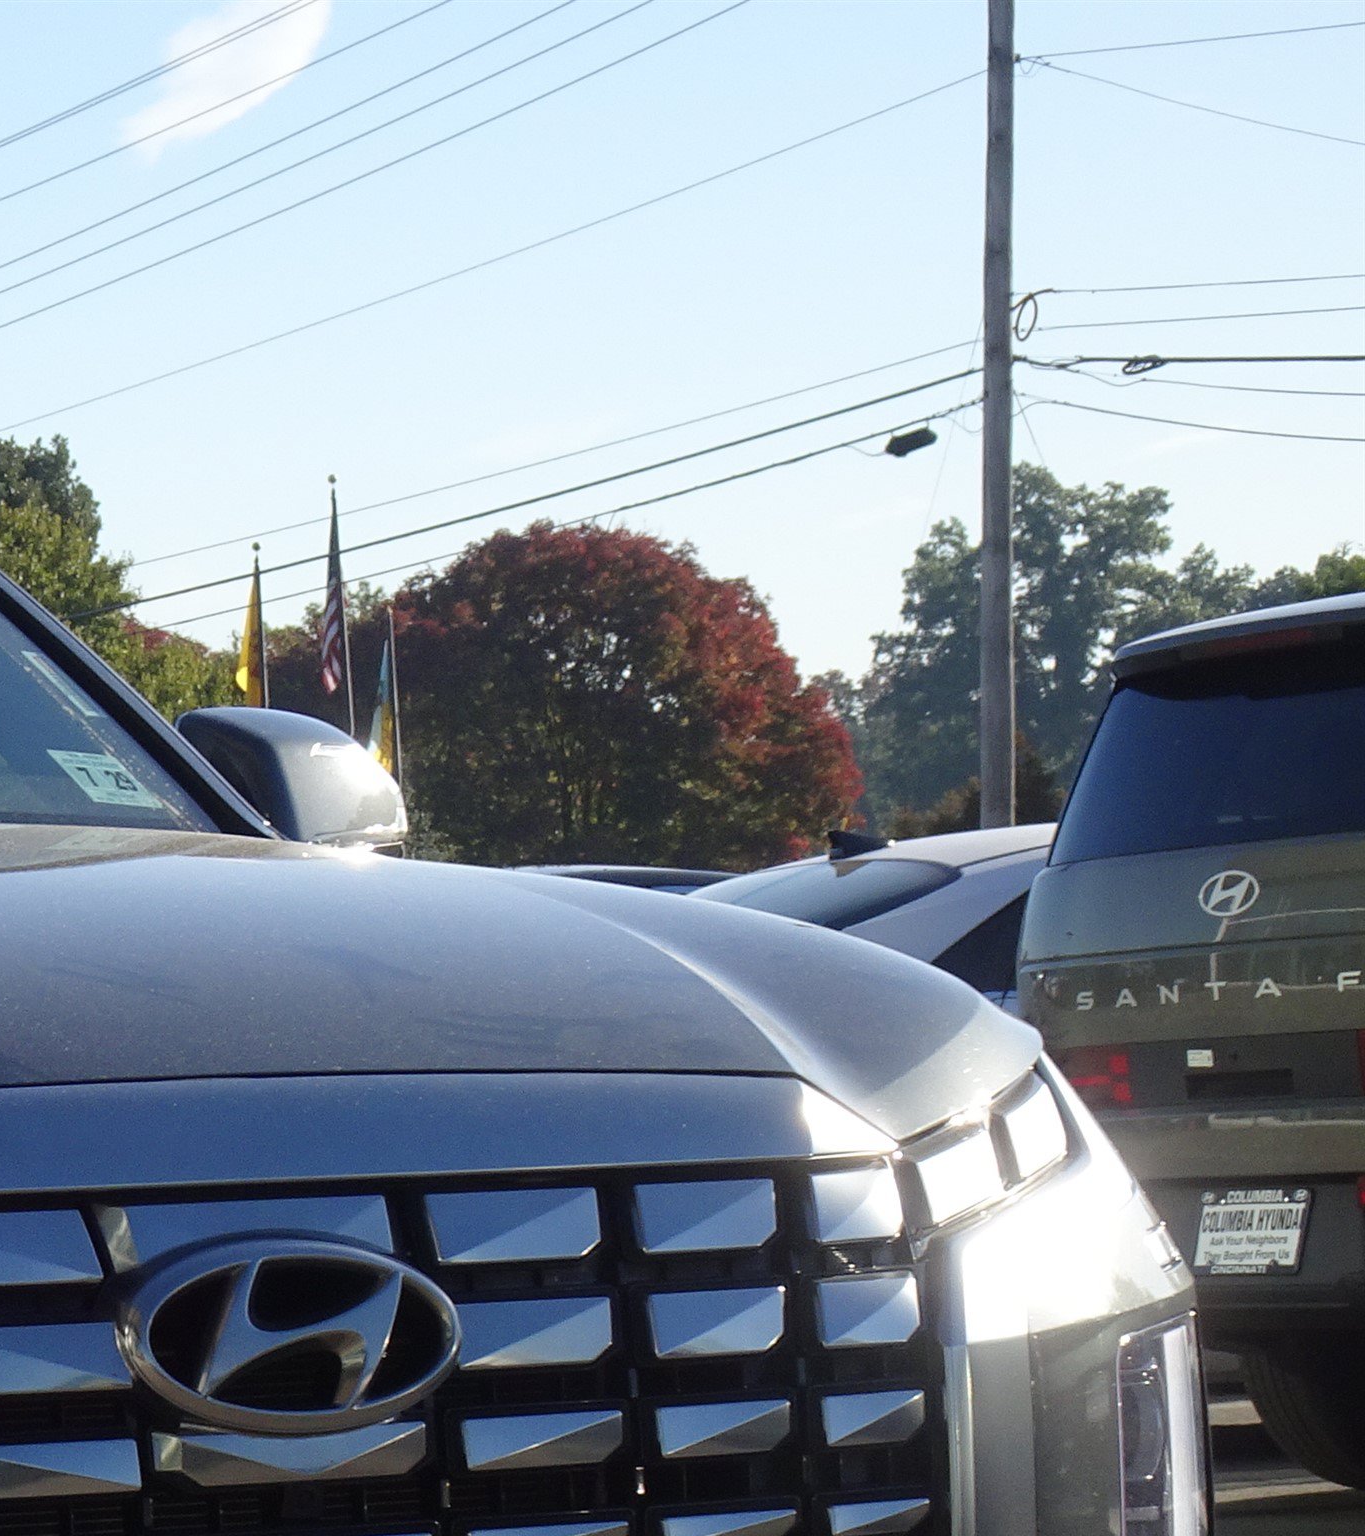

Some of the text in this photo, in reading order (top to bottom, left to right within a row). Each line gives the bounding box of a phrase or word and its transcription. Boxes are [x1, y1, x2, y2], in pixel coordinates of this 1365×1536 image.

[1076, 977, 1282, 1011] SANTA
[1227, 1189, 1283, 1203] COLUMBIA
[1202, 1208, 1300, 1232] COLUMBIA HYUNDA
[1211, 1234, 1288, 1247] Ask Your Neighbors
[1223, 1251, 1253, 1263] Bought
[1255, 1250, 1276, 1260] From
[1278, 1249, 1290, 1260] Us
[1210, 1265, 1266, 1274] CINCINNATI
